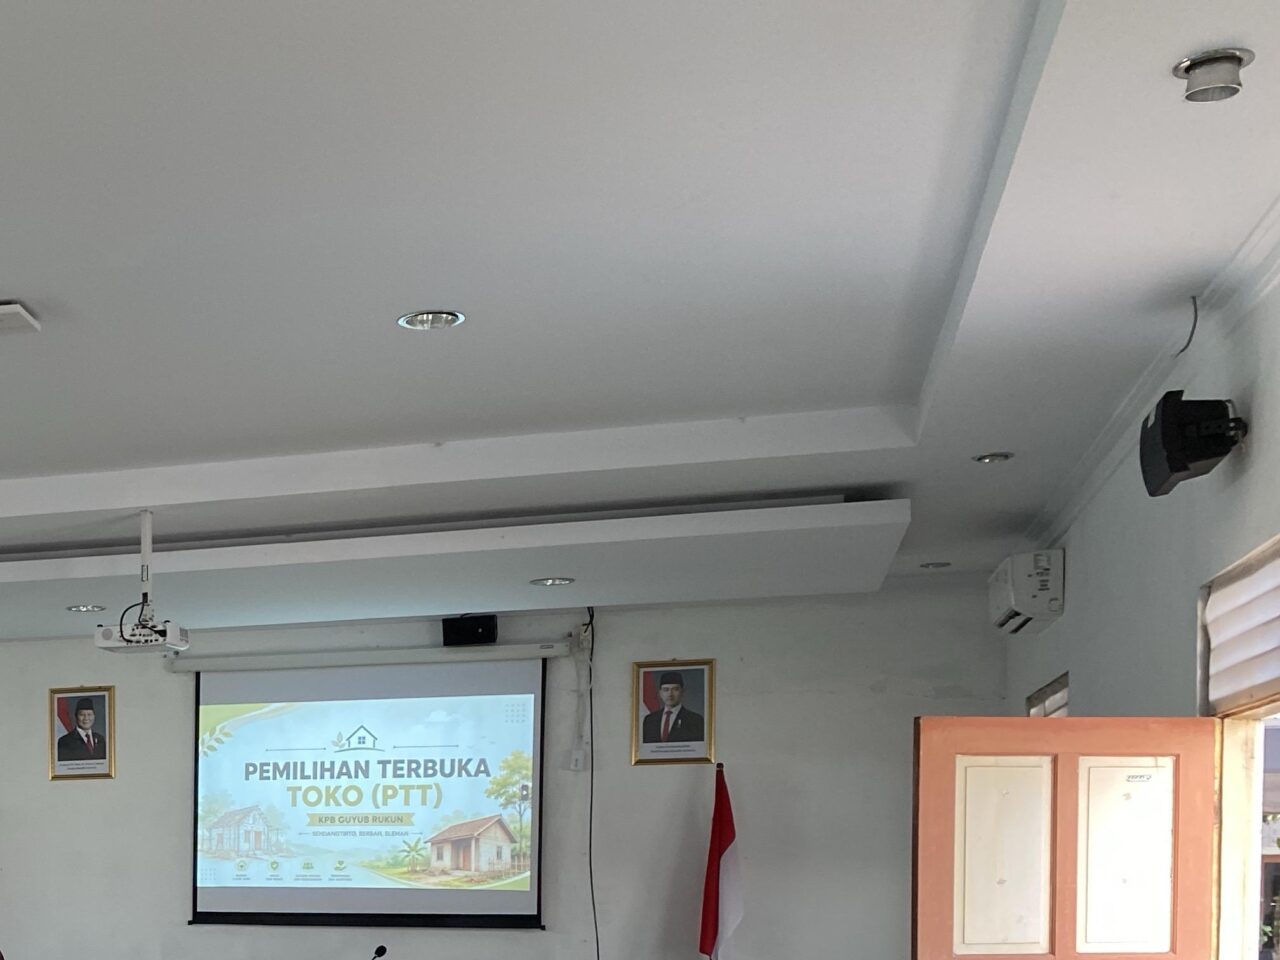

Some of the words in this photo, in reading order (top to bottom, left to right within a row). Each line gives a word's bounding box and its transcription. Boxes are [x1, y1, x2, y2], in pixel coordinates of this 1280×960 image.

[245, 760, 370, 781] PEMILIHAN
[377, 758, 491, 779] TERBUKA
[286, 785, 364, 807] TOKO
[372, 783, 442, 809] (PTT)
[318, 816, 336, 824] KPB
[338, 815, 370, 824] GUYUB
[372, 815, 404, 824] RUKUN
